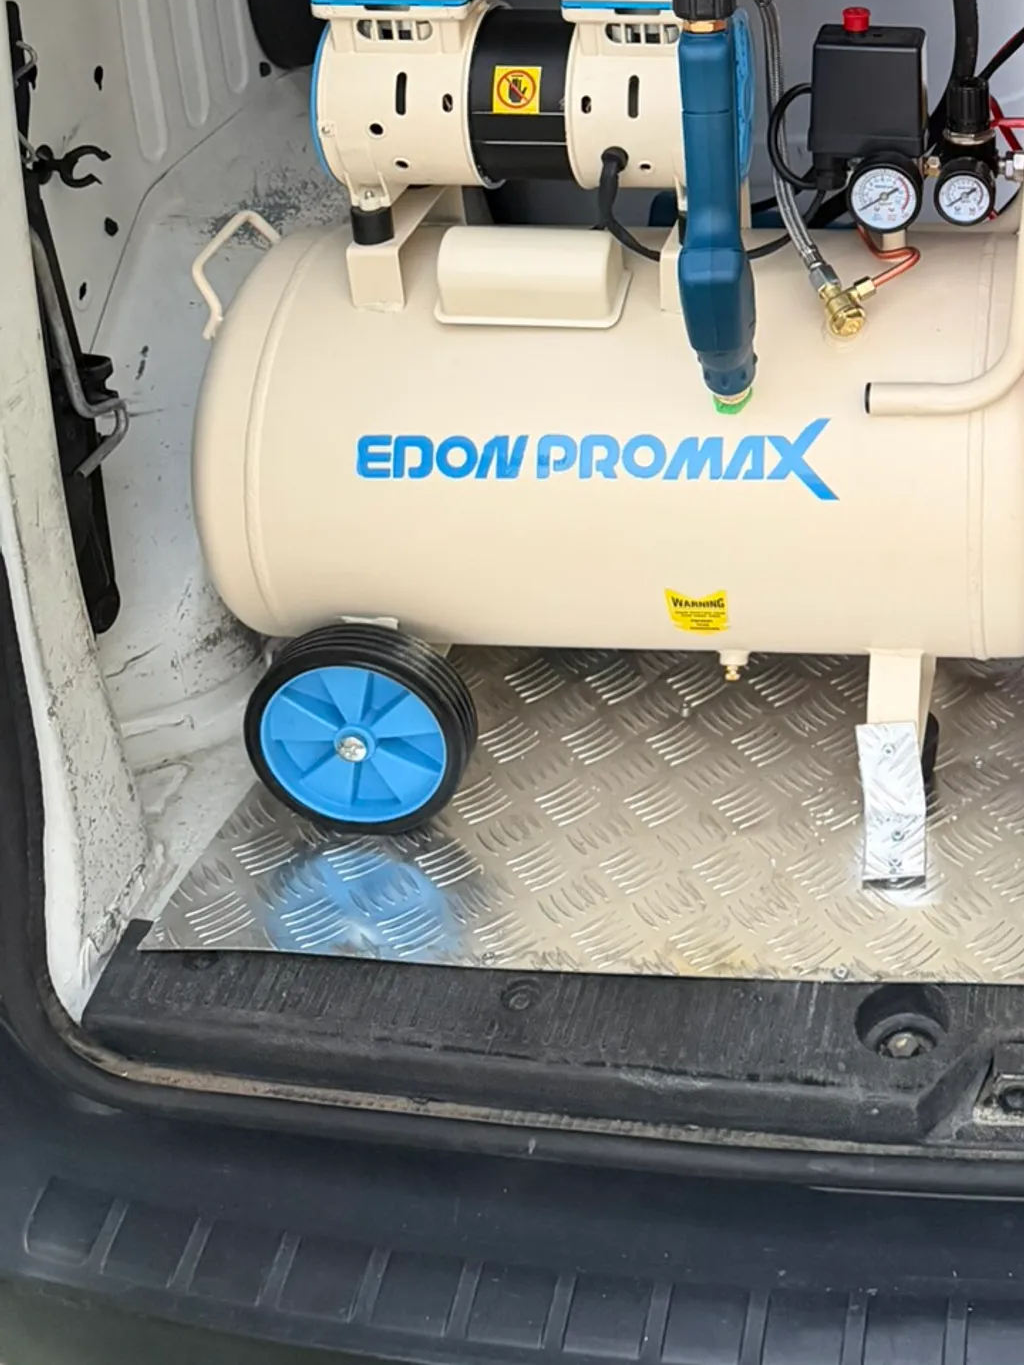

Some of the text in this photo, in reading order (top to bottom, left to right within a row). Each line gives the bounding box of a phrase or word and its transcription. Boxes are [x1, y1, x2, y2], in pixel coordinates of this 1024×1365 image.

[356, 417, 840, 501] EDON PROMAX
[671, 595, 725, 608] WARNING
